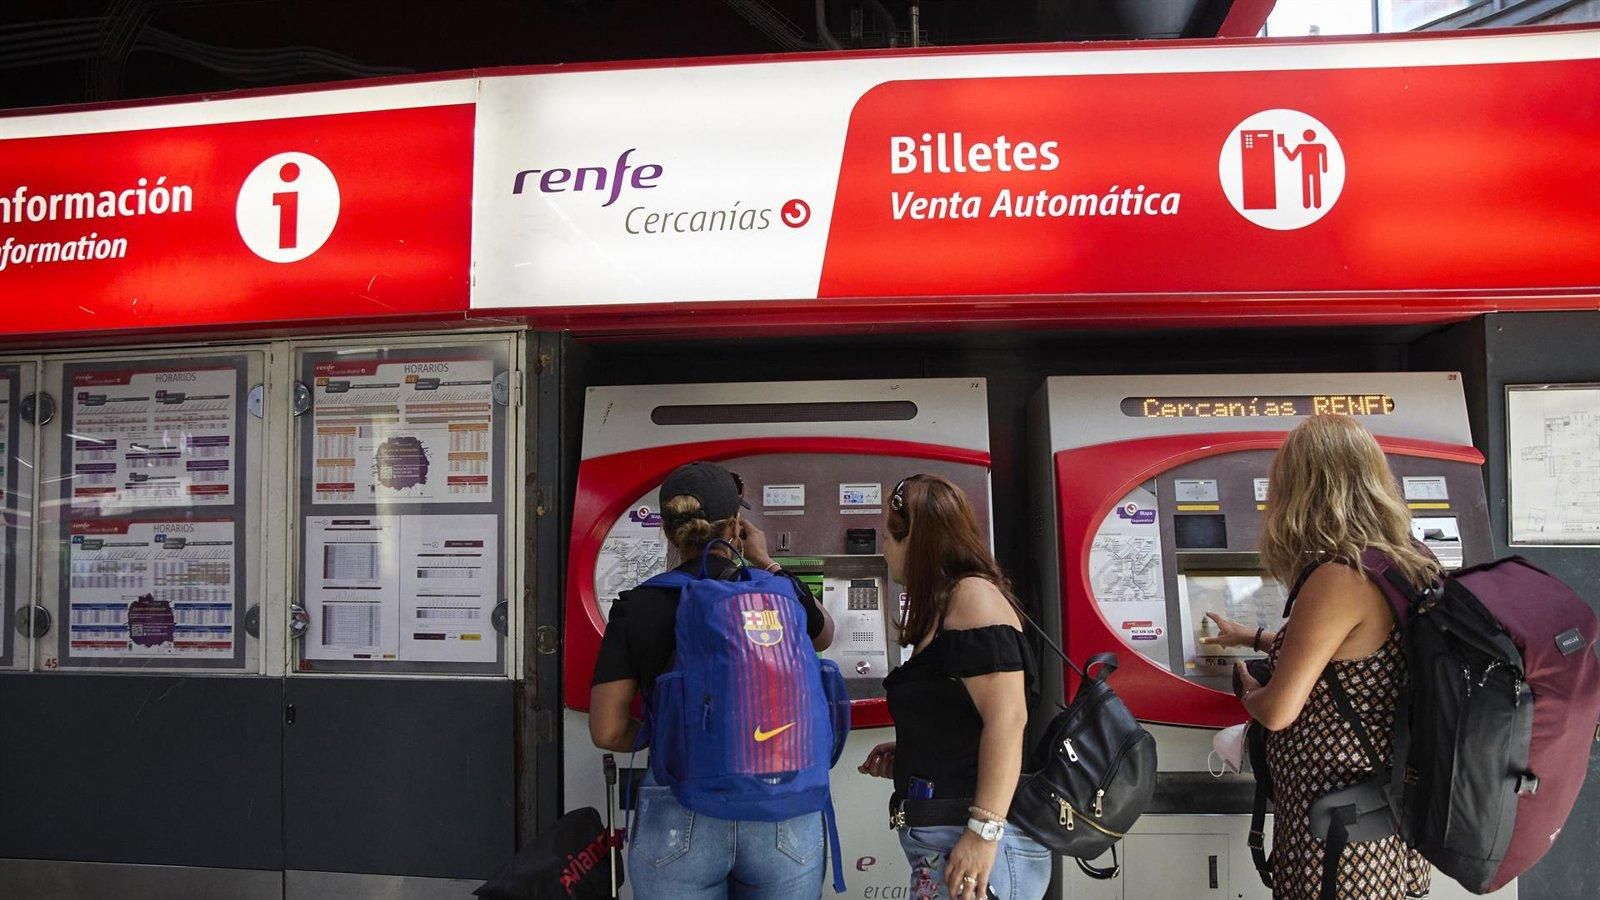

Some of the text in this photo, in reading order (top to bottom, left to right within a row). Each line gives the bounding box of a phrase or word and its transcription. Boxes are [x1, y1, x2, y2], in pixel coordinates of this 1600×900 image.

[891, 132, 1060, 174] Billetes
[512, 148, 663, 207] renfe
[891, 184, 1181, 220] Venta Automática
[625, 201, 771, 235] Cercanías
[0, 232, 128, 272] formation
[155, 372, 197, 383] HORARIOS
[404, 363, 449, 374] HORARIOS
[1143, 397, 1296, 418] Cercanías
[153, 523, 195, 534] HORARIOS
[44, 658, 58, 669] 45
